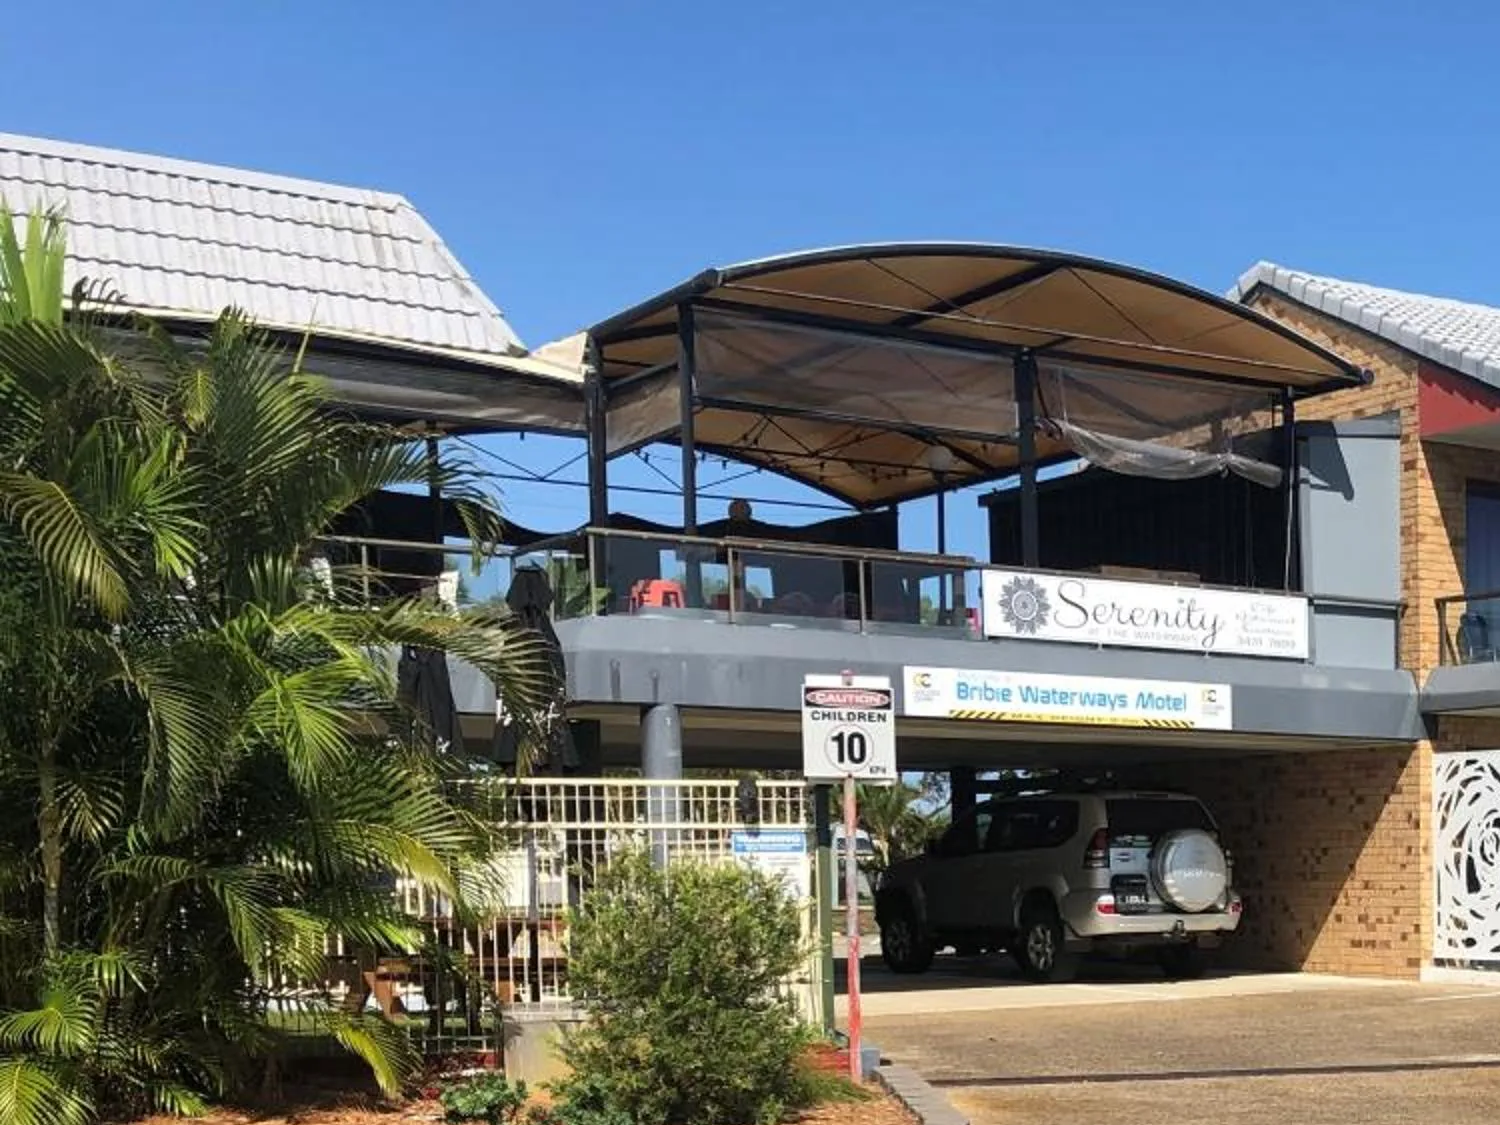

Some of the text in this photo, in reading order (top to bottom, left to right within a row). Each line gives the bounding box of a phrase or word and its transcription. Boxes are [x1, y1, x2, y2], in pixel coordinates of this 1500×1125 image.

[1053, 579, 1227, 648] Serenity
[815, 693, 881, 704] CAUTION
[956, 681, 1011, 703] Bribie
[1018, 685, 1128, 711] Waterways
[1135, 691, 1188, 711] Motel
[811, 710, 887, 722] CHILDREN
[831, 731, 866, 764] 10
